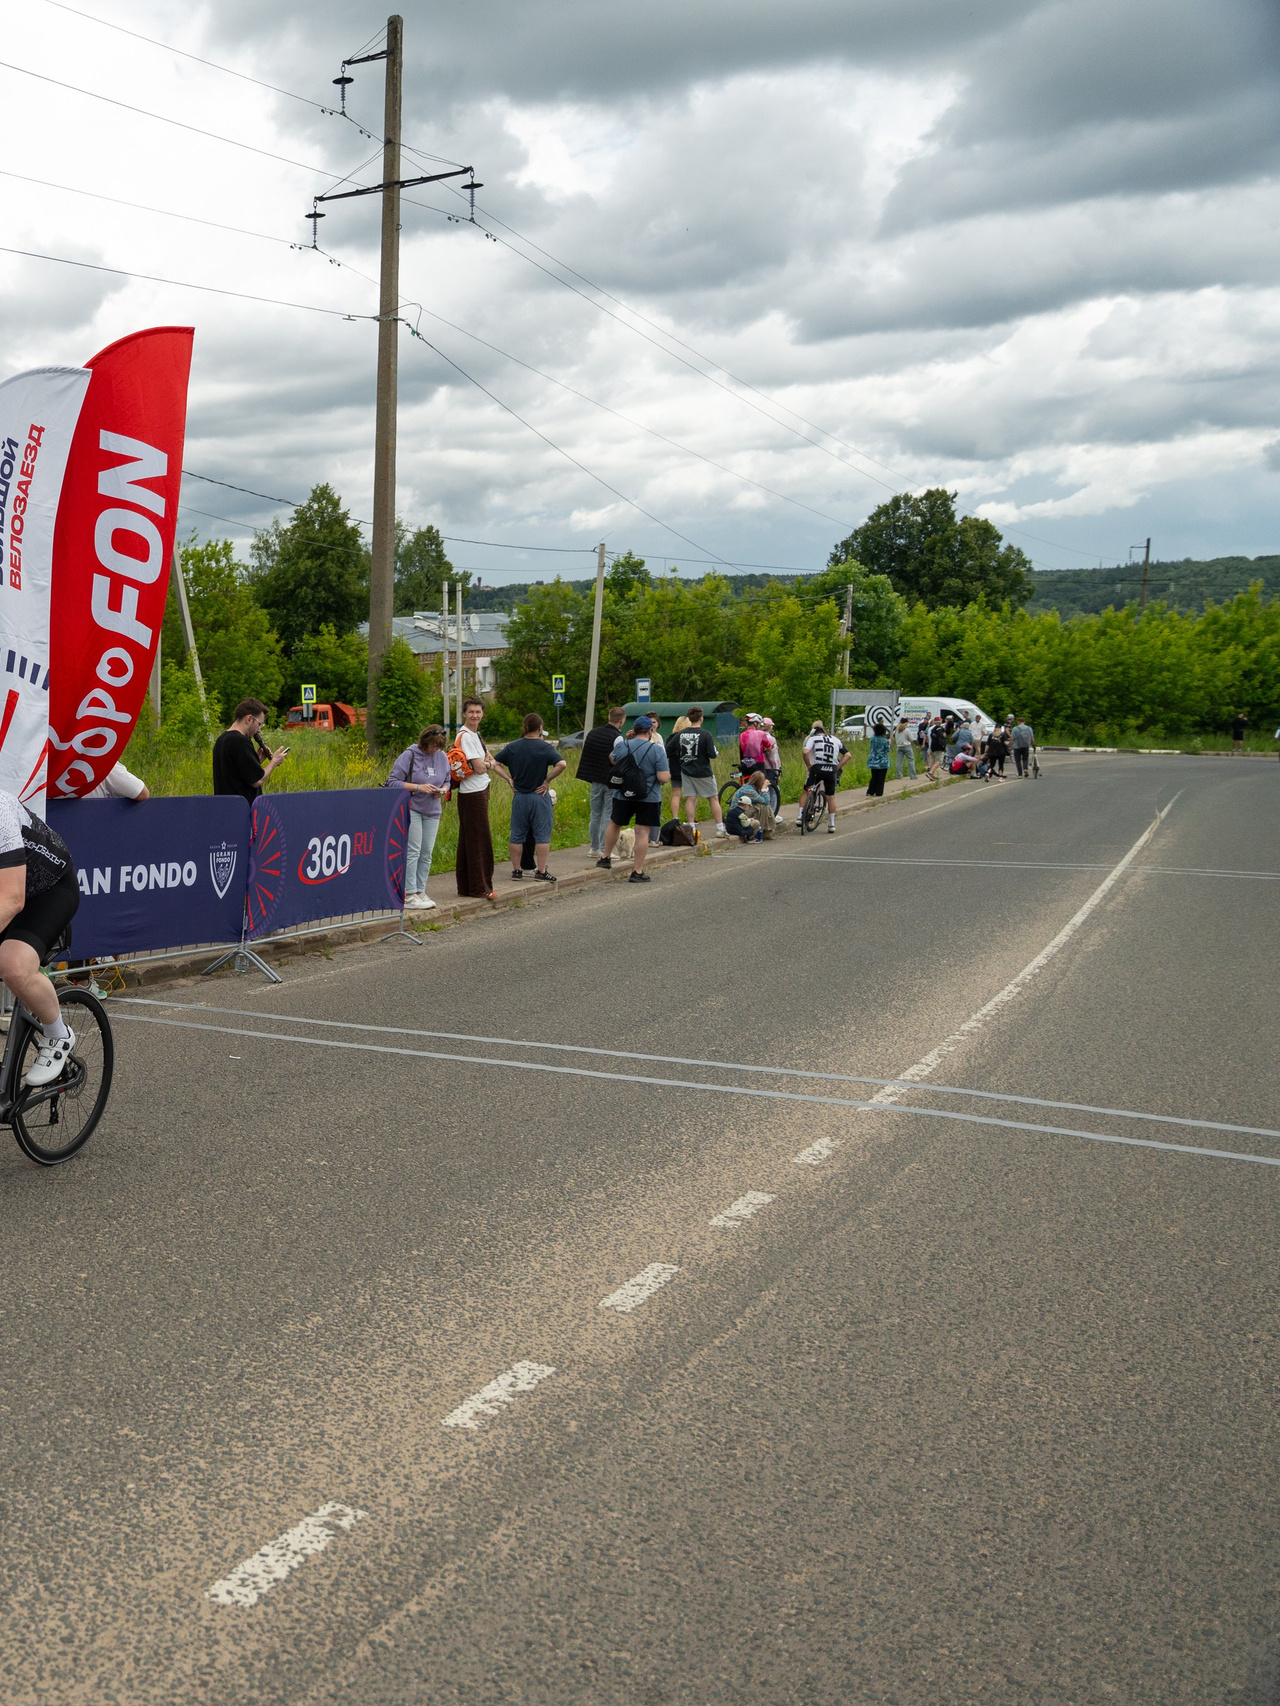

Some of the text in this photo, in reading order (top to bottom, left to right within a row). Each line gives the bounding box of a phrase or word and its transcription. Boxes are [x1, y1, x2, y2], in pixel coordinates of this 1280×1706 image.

[9, 423, 46, 591] ВЕЛОЗАЕЗД
[48, 429, 168, 799] оброFON
[77, 861, 197, 895] AN FONDO
